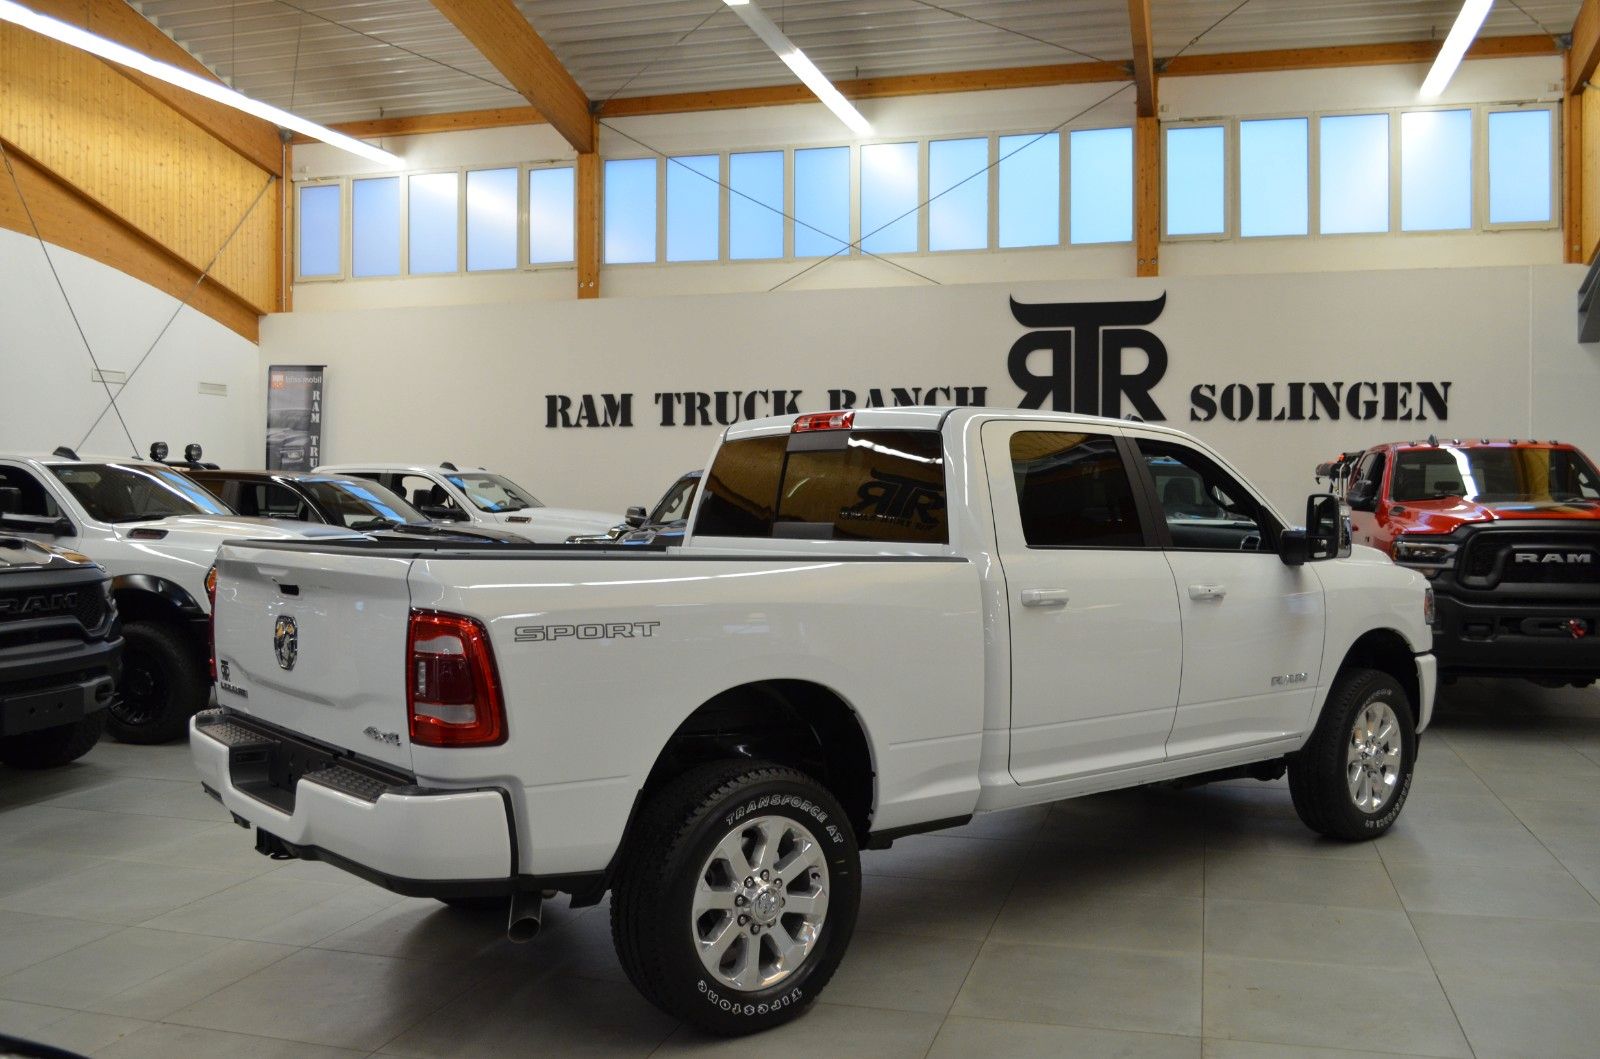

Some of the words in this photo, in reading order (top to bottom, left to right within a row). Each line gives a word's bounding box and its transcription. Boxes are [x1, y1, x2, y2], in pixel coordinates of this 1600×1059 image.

[310, 390, 321, 424] RAM
[544, 393, 633, 428] RAM
[655, 389, 803, 427] TRUCK
[827, 385, 988, 411] RANCH
[1190, 381, 1452, 422] SOLINGEN
[1514, 553, 1592, 564] RAM
[514, 621, 661, 643] SPORT
[725, 794, 829, 826] TRANSFORCE
[825, 823, 844, 844] AT
